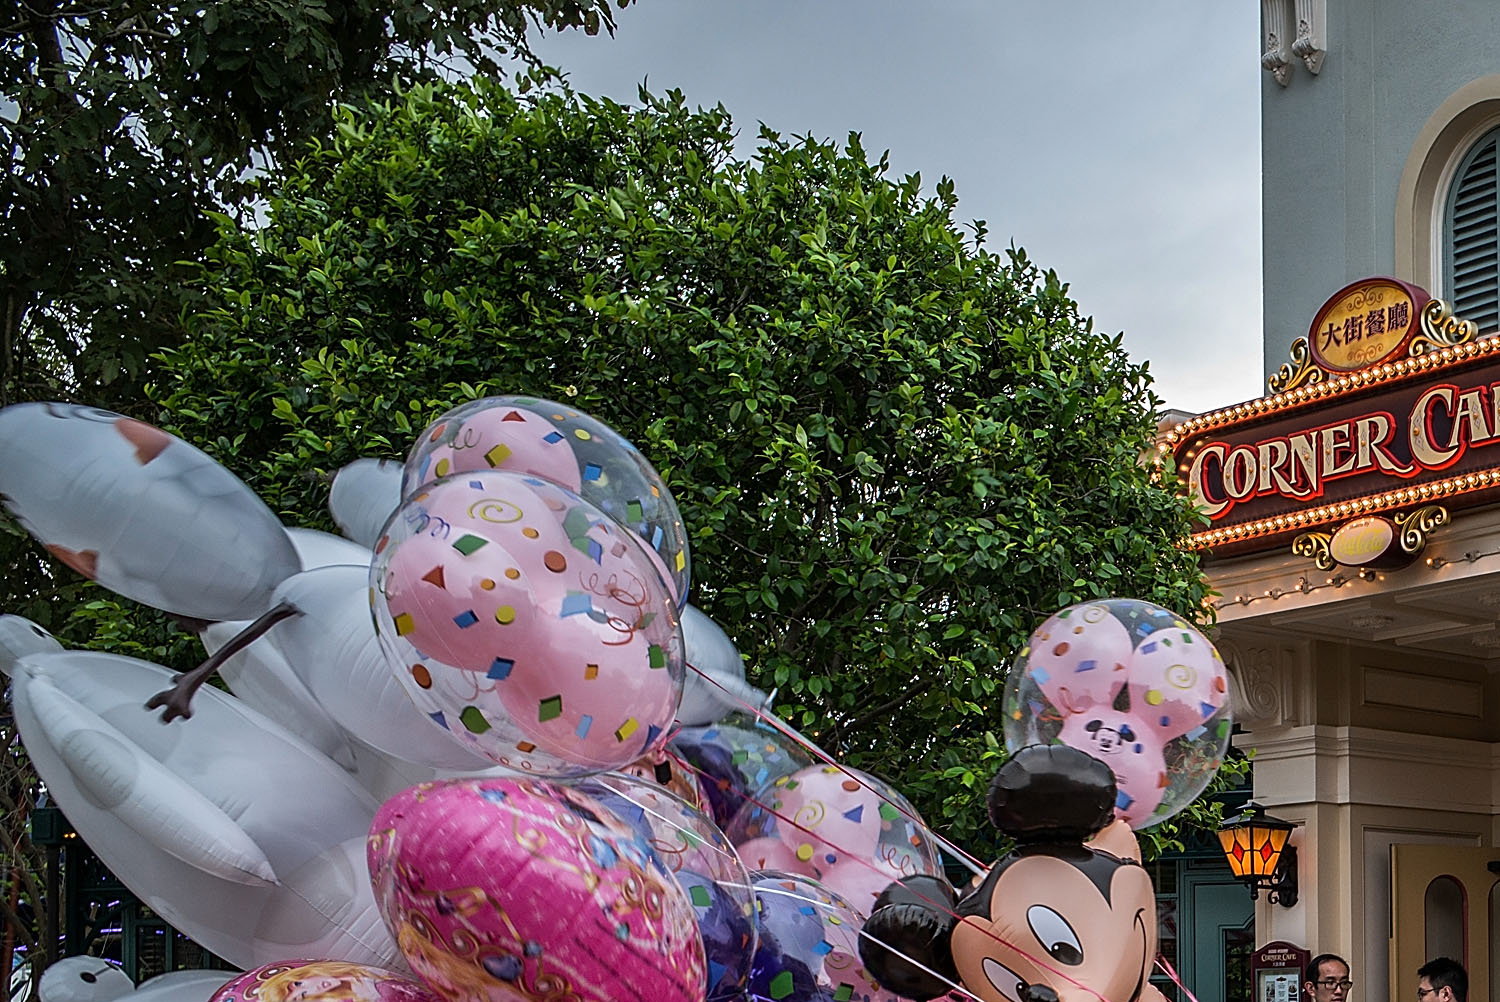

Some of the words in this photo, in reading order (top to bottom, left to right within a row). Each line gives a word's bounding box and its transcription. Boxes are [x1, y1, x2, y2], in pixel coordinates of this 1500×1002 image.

[1320, 301, 1409, 352] 大街餐廳
[1188, 411, 1414, 517] CORNER
